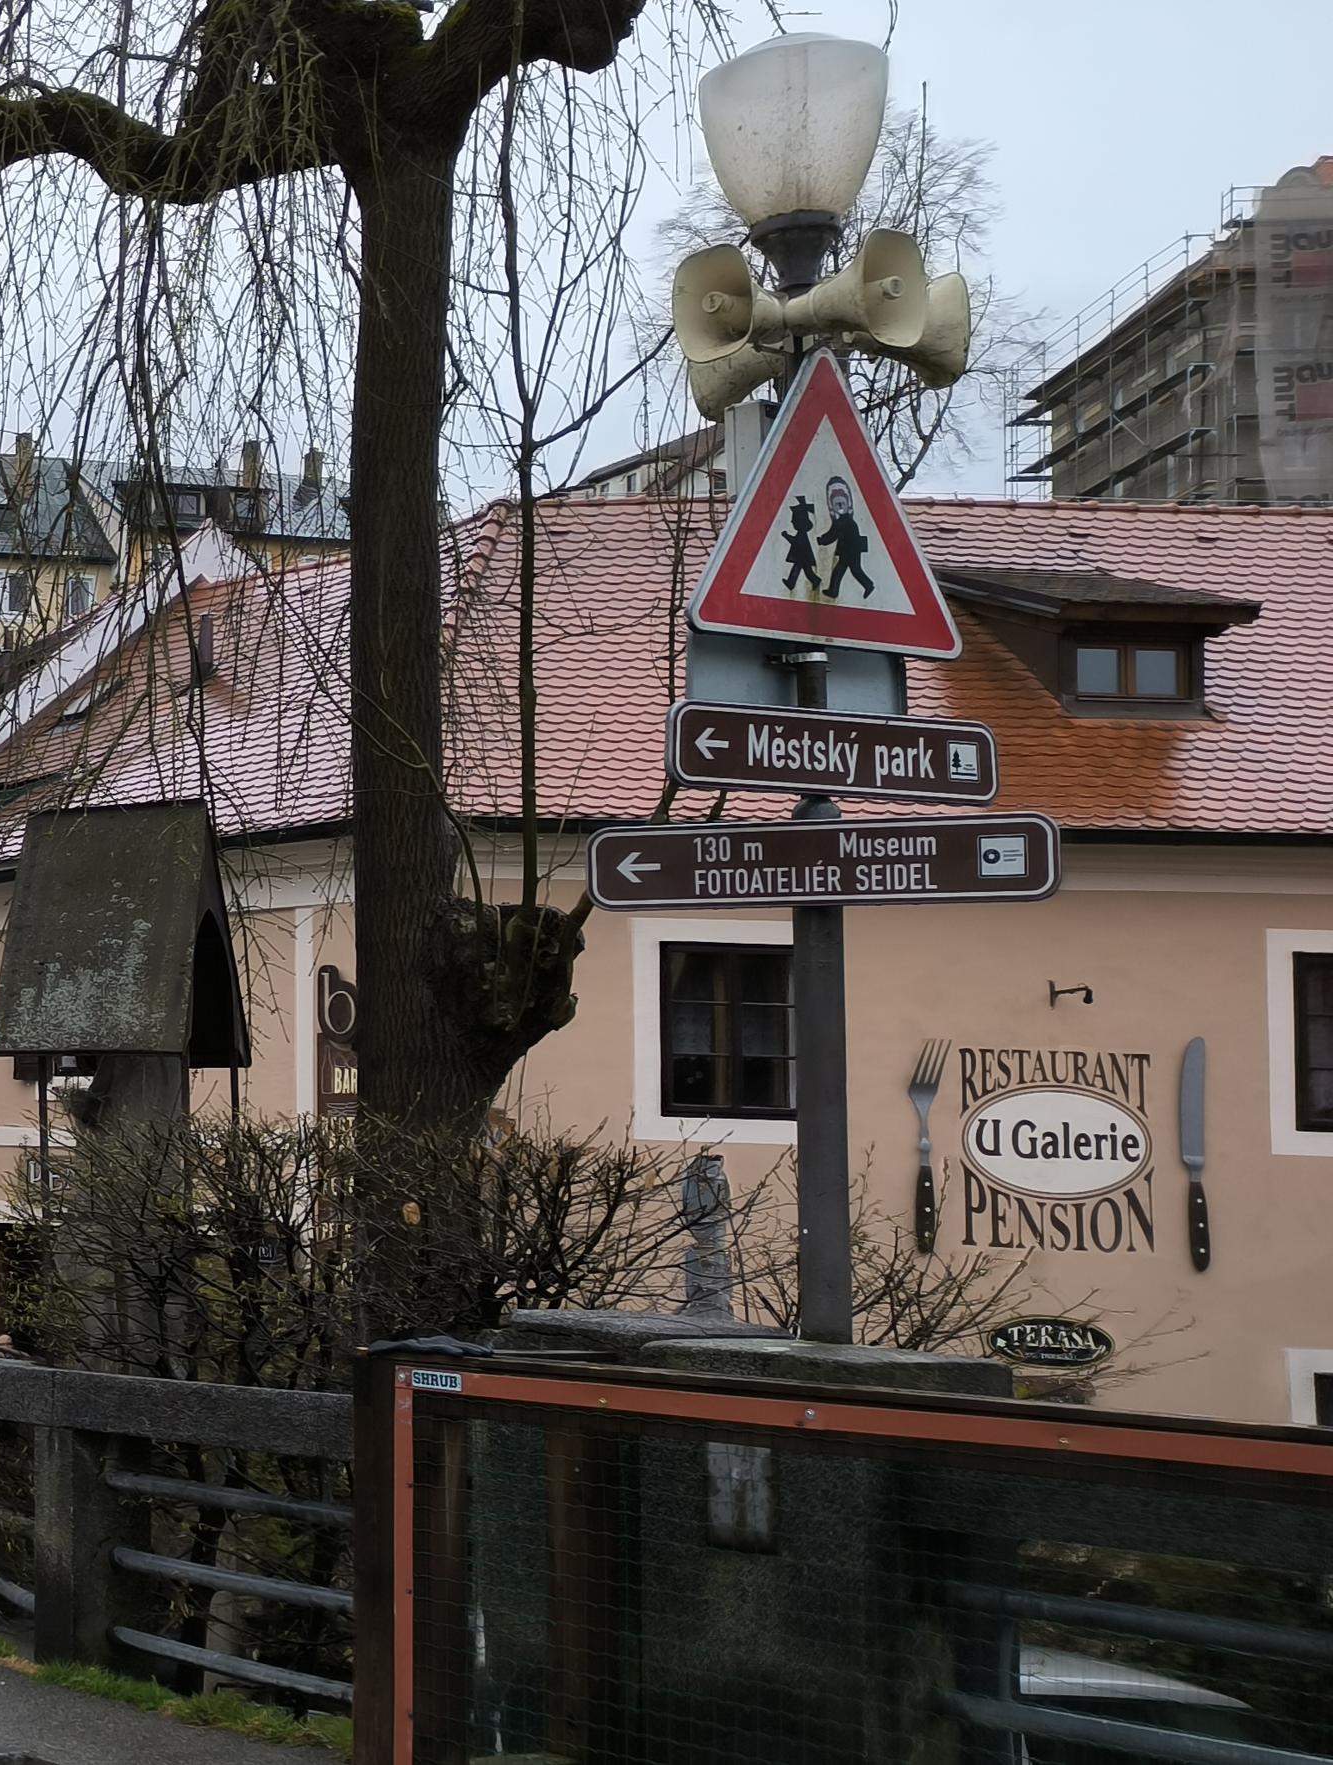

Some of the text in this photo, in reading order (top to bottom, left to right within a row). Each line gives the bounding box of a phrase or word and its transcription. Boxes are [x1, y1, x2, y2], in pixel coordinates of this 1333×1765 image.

[747, 723, 936, 787] Městský park
[693, 832, 937, 863] 130 m Museum
[694, 859, 937, 896] FOTOATELIÉR SEIDEL
[958, 1047, 1151, 1119] RESTAURANT
[975, 1118, 1141, 1163] U Galerie
[961, 1158, 1156, 1254] PENSION
